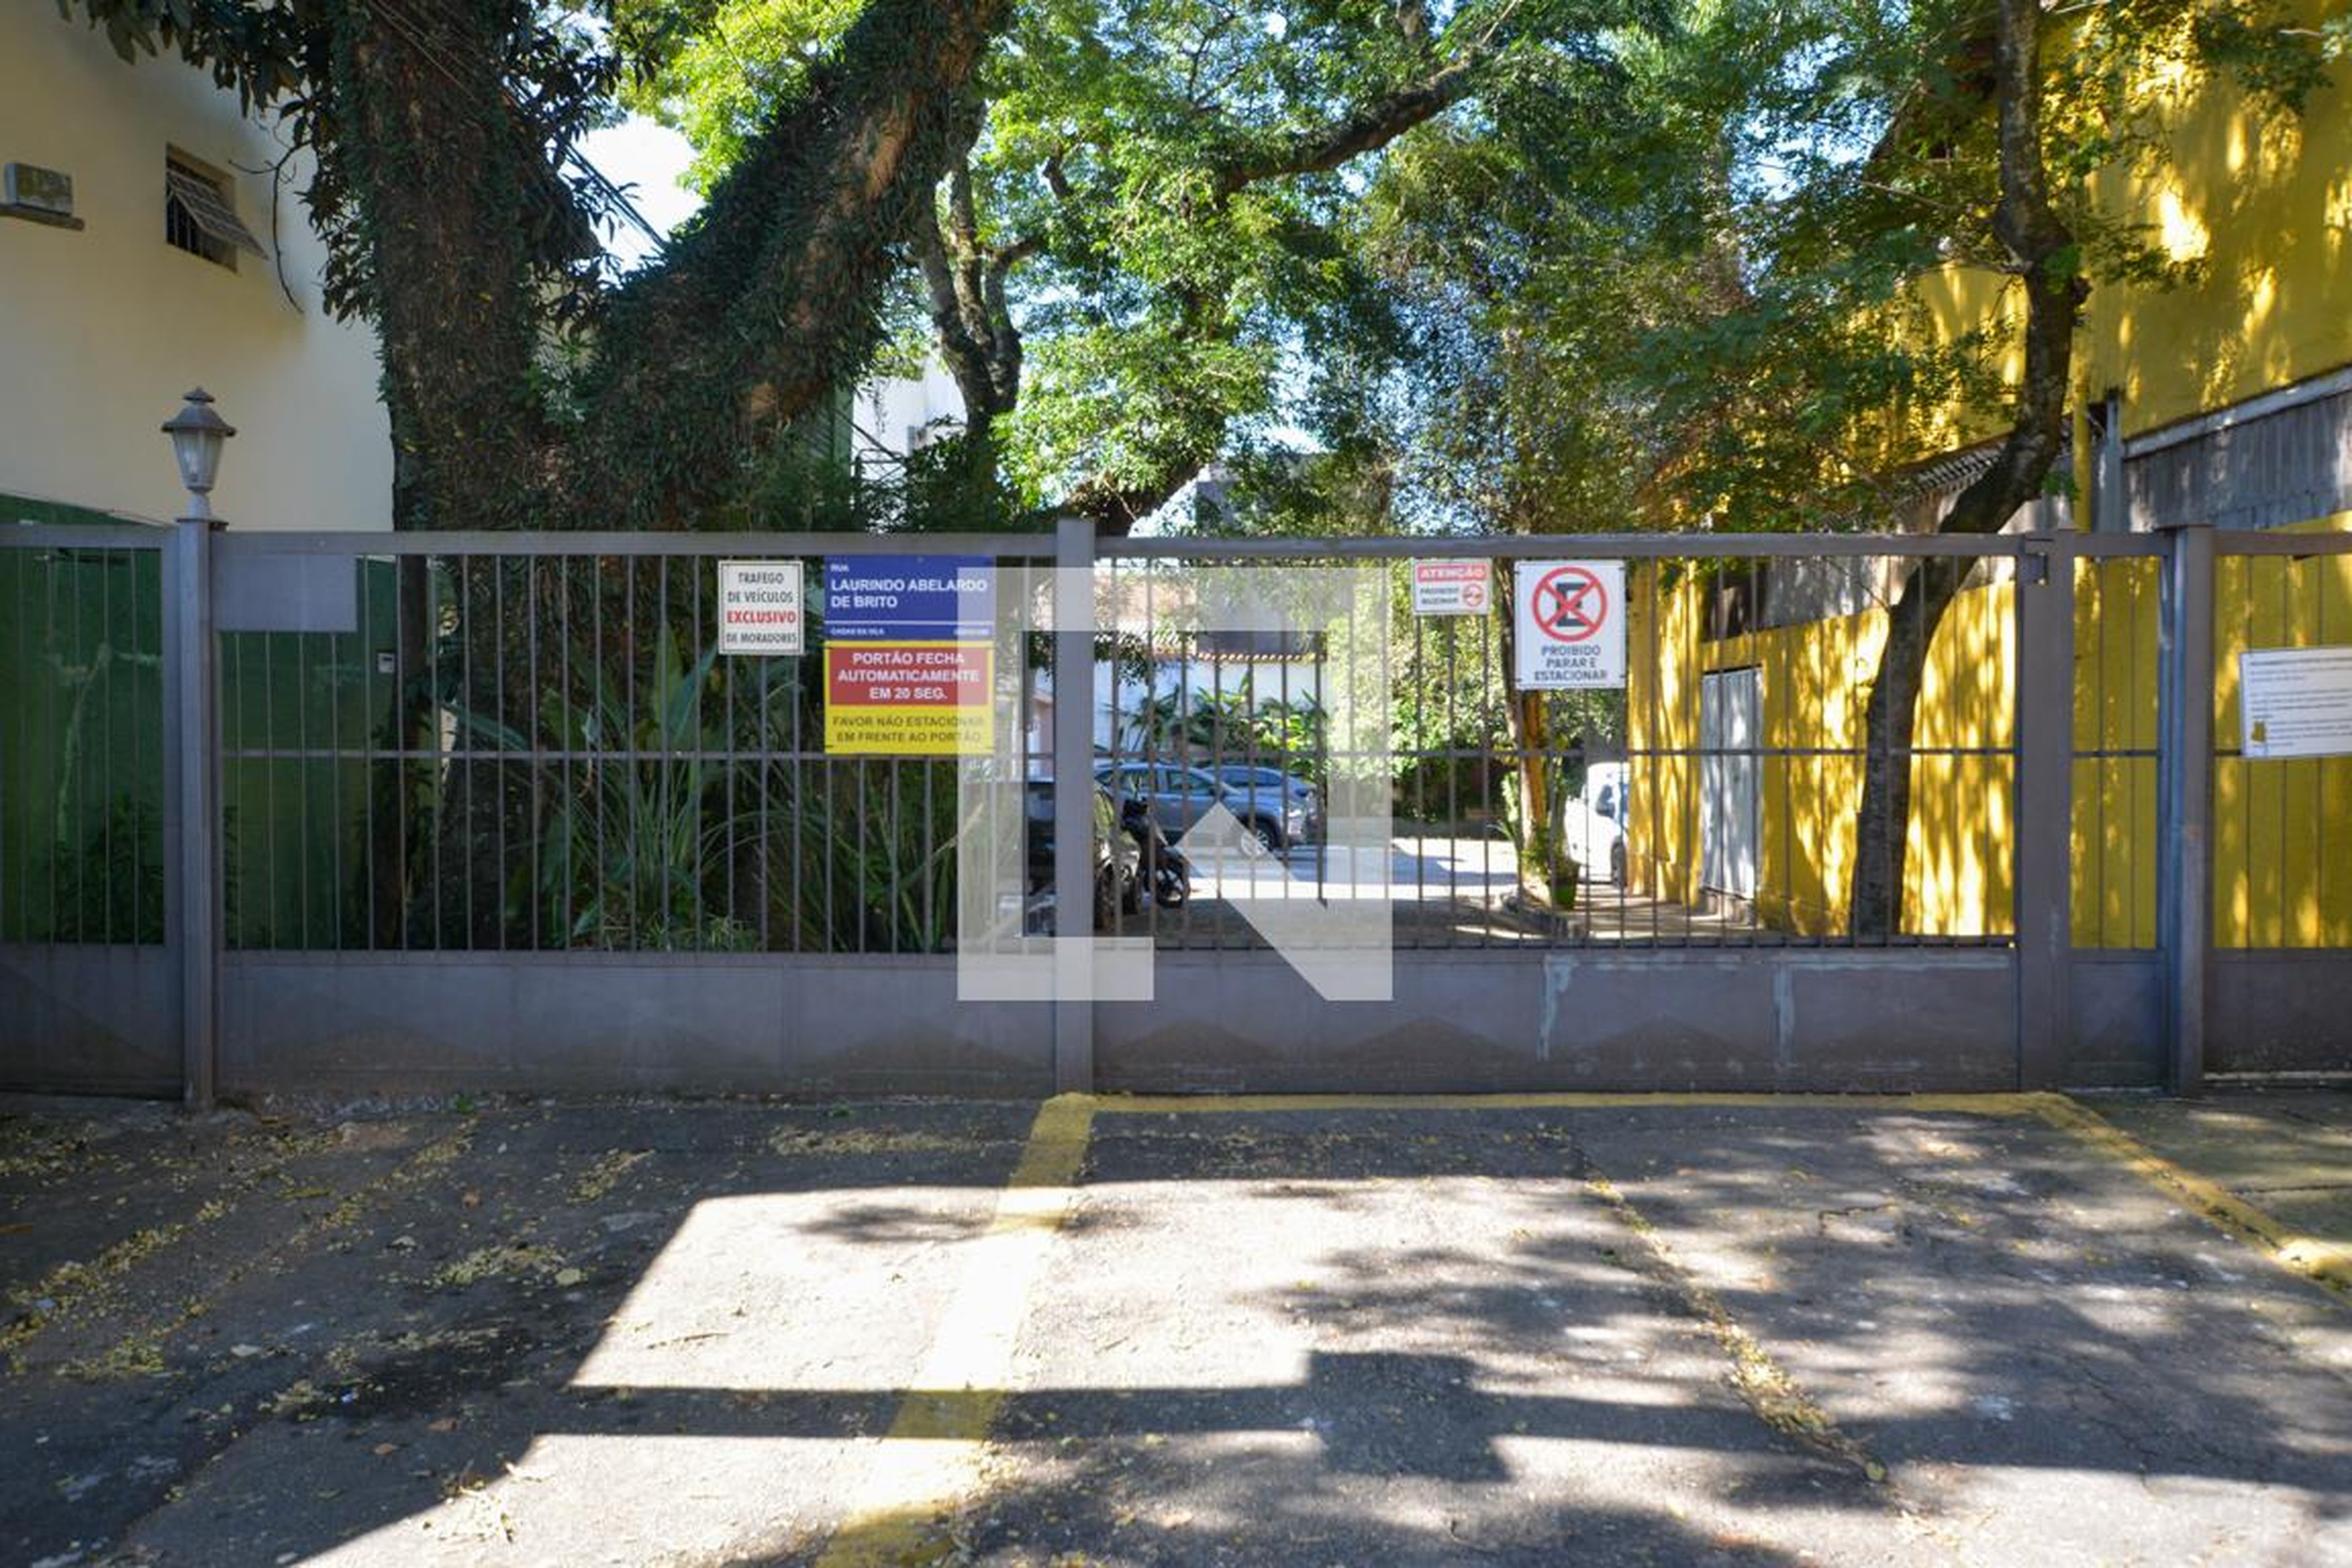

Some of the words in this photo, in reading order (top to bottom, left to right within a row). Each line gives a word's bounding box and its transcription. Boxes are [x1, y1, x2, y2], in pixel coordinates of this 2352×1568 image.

[831, 579, 905, 591] LAURINDO
[908, 579, 987, 592] ABELARDO
[728, 591, 740, 603] DE
[745, 589, 793, 603] VEÍCULOS
[831, 595, 850, 608] DE
[854, 595, 898, 608] BRITO
[726, 611, 796, 624] EXCLUSIVO
[726, 633, 737, 643] DE
[741, 633, 796, 643] MORADORES
[1541, 646, 1601, 656] PROIBIDO
[852, 650, 913, 665] PORTÃO
[916, 652, 965, 665] FECHA
[1546, 657, 1588, 668] PARAR
[1589, 657, 1596, 668] E
[838, 669, 980, 682] AUTOMATICAMENTE
[1534, 670, 1607, 681] ESTACIONAR
[869, 687, 891, 699] EM
[894, 687, 911, 699] 20
[914, 687, 948, 699] SEG.
[833, 715, 873, 726] FAVOR
[837, 732, 855, 742] EM
[858, 732, 903, 742] FRENTE
[910, 732, 927, 742] AO
